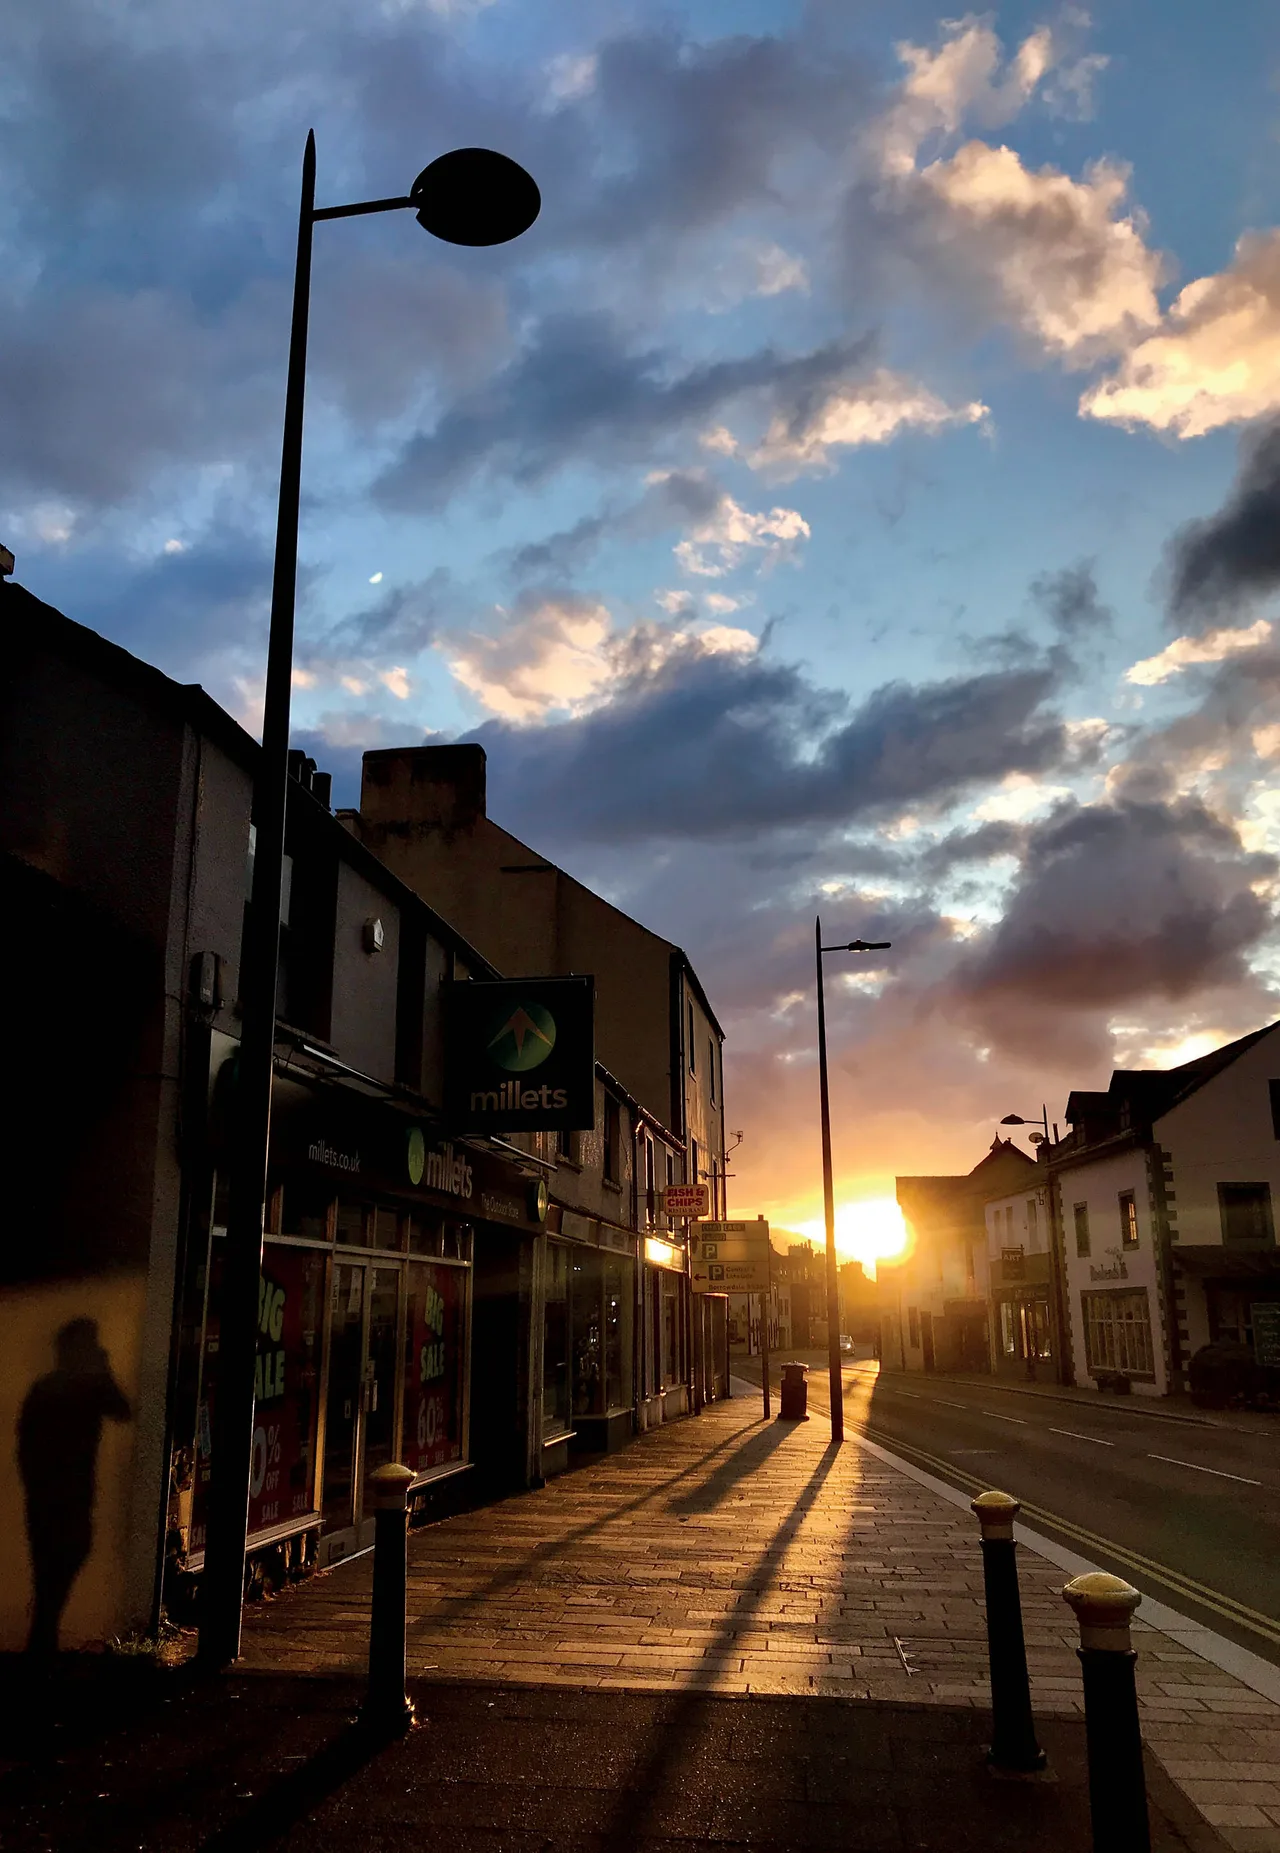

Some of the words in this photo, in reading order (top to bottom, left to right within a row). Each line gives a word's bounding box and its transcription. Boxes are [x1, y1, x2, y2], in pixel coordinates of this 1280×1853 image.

[470, 1080, 569, 1112] millets
[308, 1140, 362, 1173] millets.co.uk
[426, 1142, 473, 1199] millets
[667, 1187, 693, 1197] FISH
[695, 1187, 705, 1197] &
[667, 1197, 703, 1207] CHIPS
[425, 1285, 444, 1336] BIG
[254, 1351, 285, 1401] ALE
[420, 1341, 445, 1383] SALE
[265, 1469, 281, 1492] OFF
[261, 1500, 279, 1524] SALE
